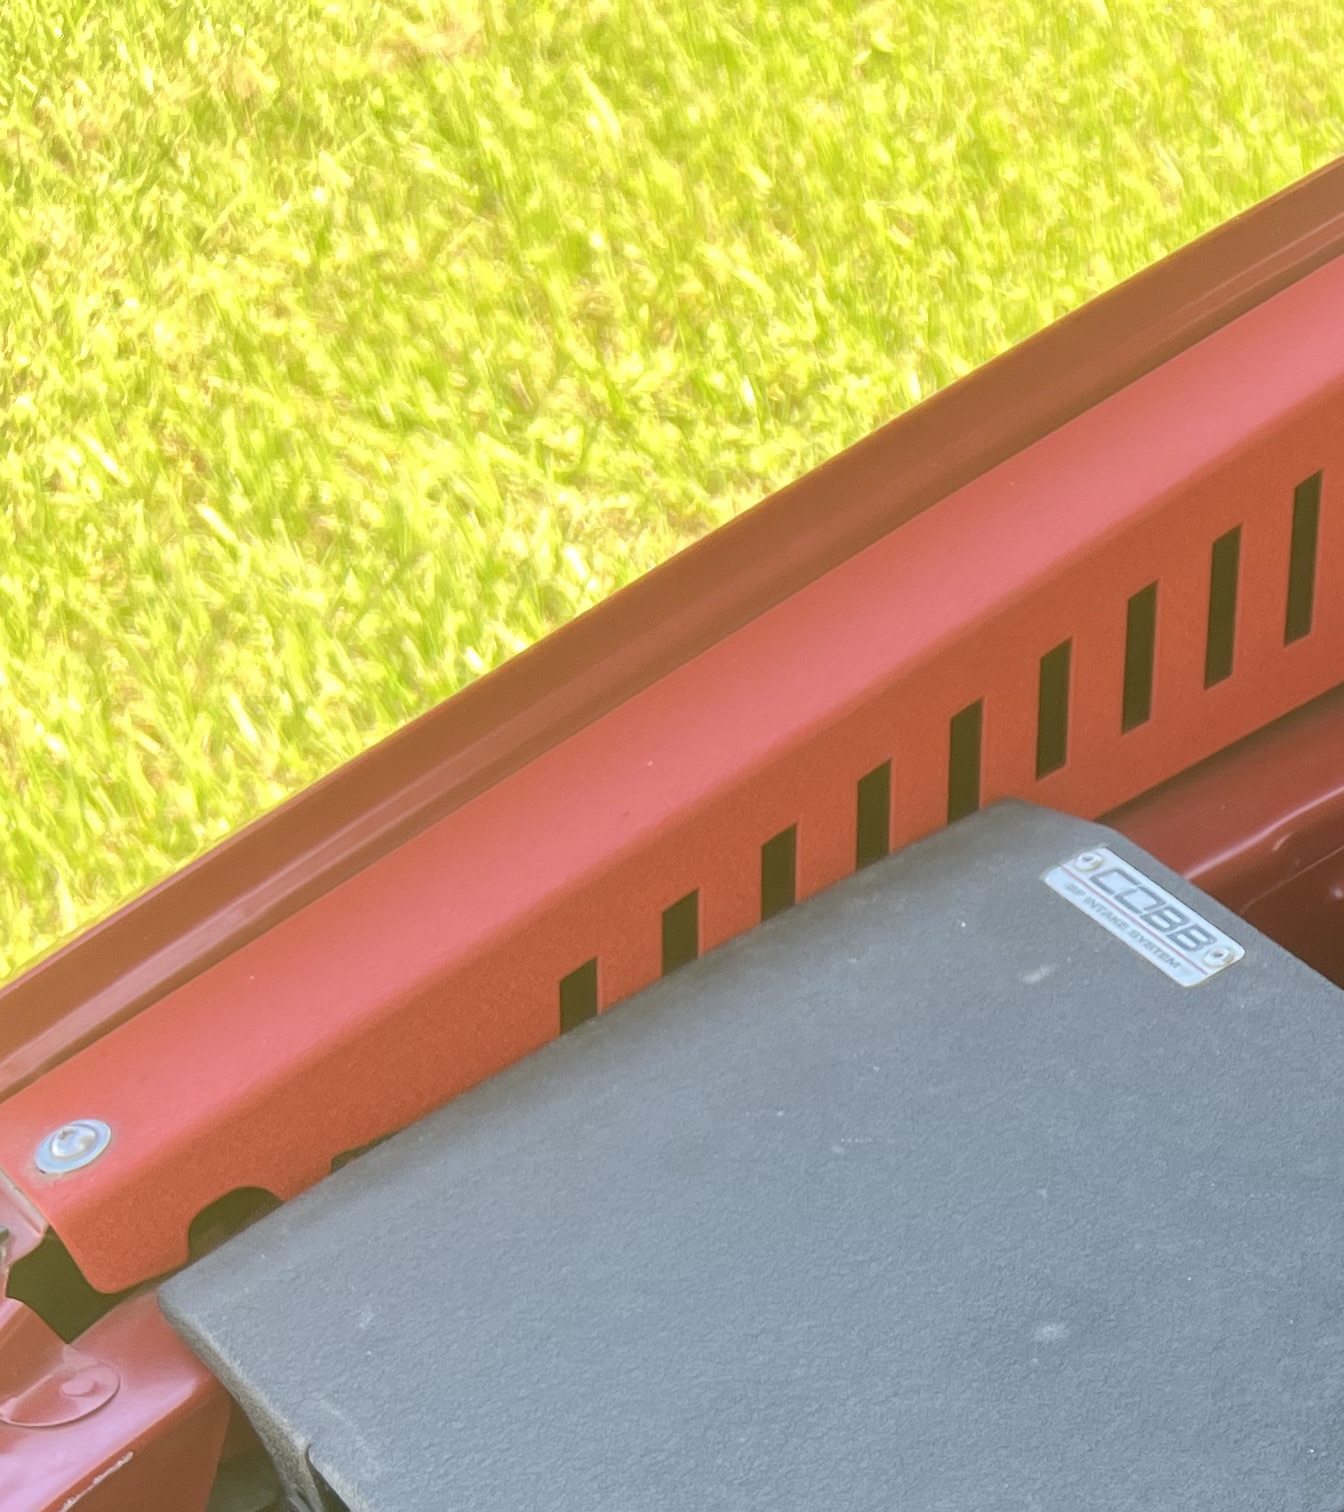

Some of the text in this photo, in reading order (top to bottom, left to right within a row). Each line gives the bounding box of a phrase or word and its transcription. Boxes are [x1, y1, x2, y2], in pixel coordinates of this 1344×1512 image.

[1083, 893, 1130, 932] INTAKE
[1128, 926, 1181, 970] SYSTEM
[1089, 868, 1217, 952] COBB
